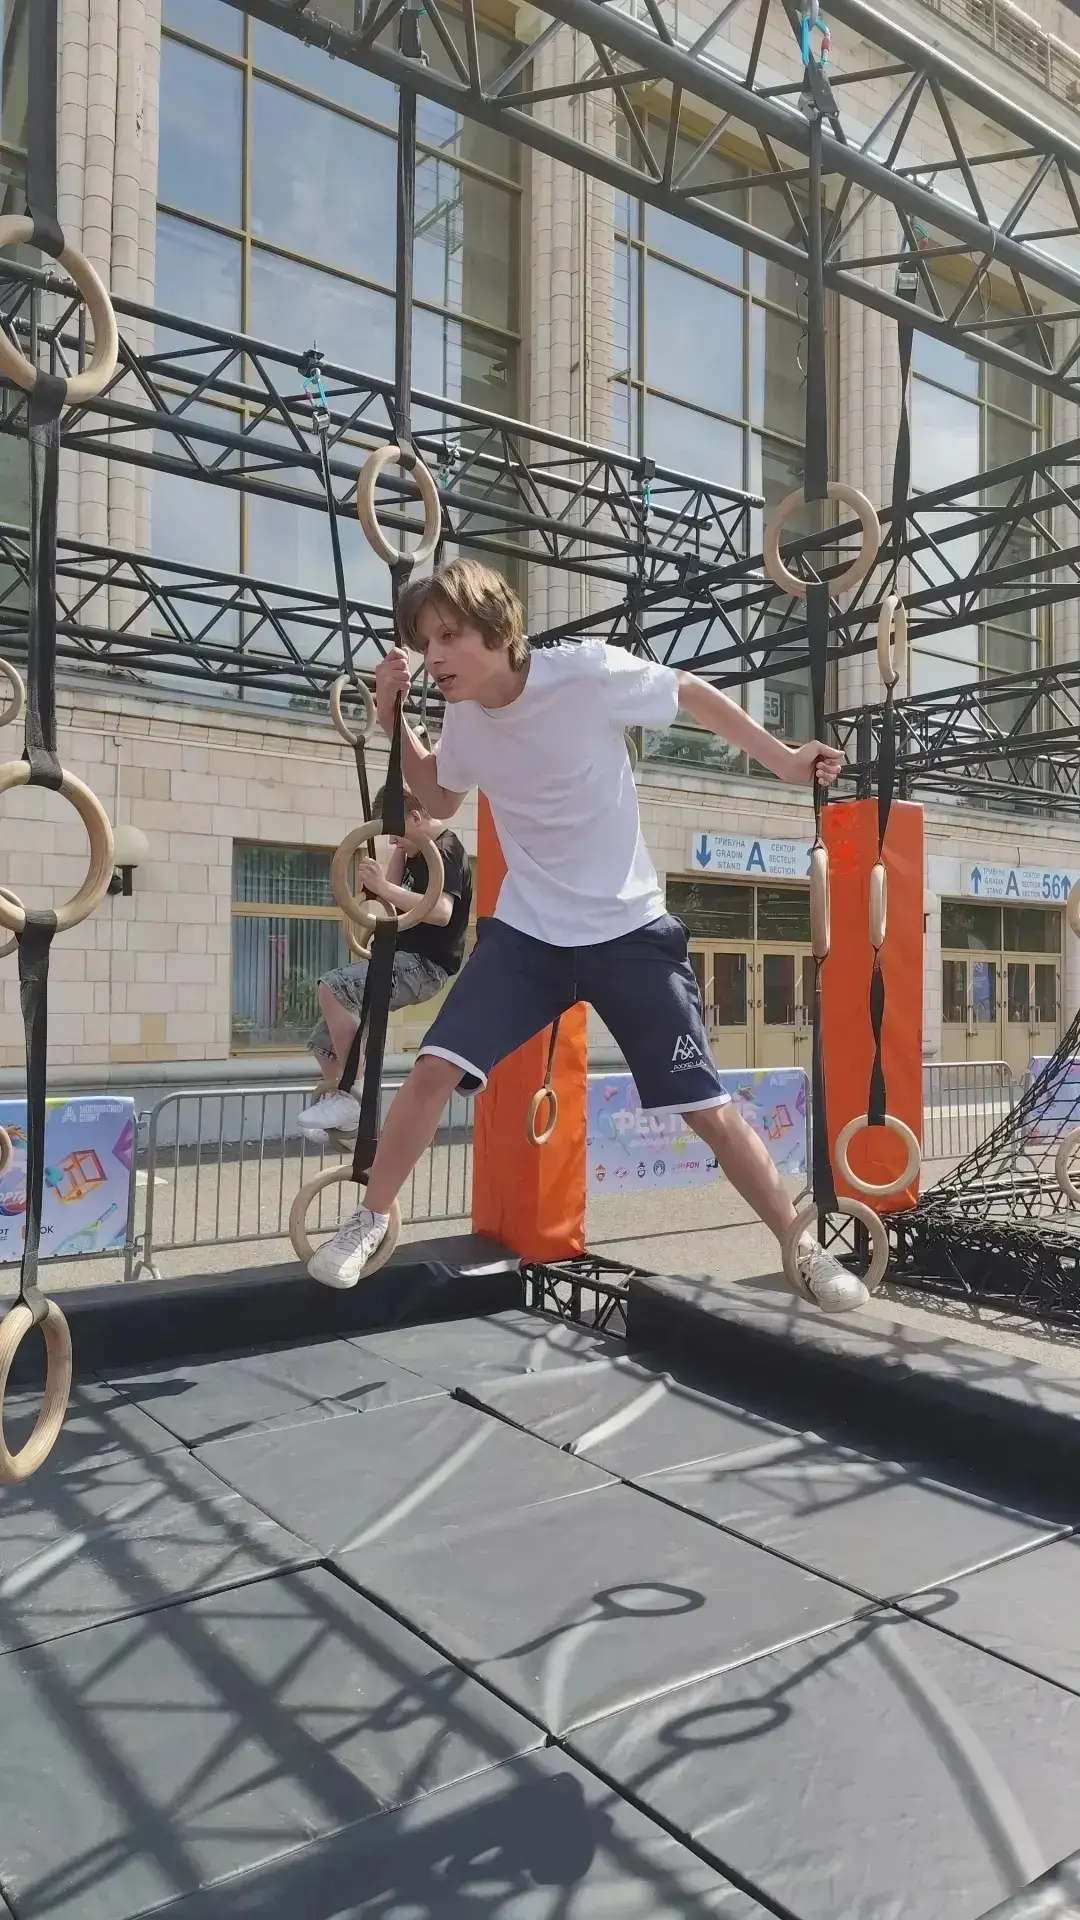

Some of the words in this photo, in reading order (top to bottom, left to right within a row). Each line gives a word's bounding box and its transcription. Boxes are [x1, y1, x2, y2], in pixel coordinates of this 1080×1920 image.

[714, 837, 746, 848] ТРИБУНА
[771, 843, 796, 853] СЕКТОР
[715, 849, 743, 860] GRADIN
[768, 854, 796, 864] SECTEUR
[717, 861, 741, 870] STAND
[769, 865, 796, 875] SECTION
[1022, 871, 1041, 879] СЕКТОР
[986, 887, 1003, 895] STAND
[1021, 890, 1041, 898] SECTION
